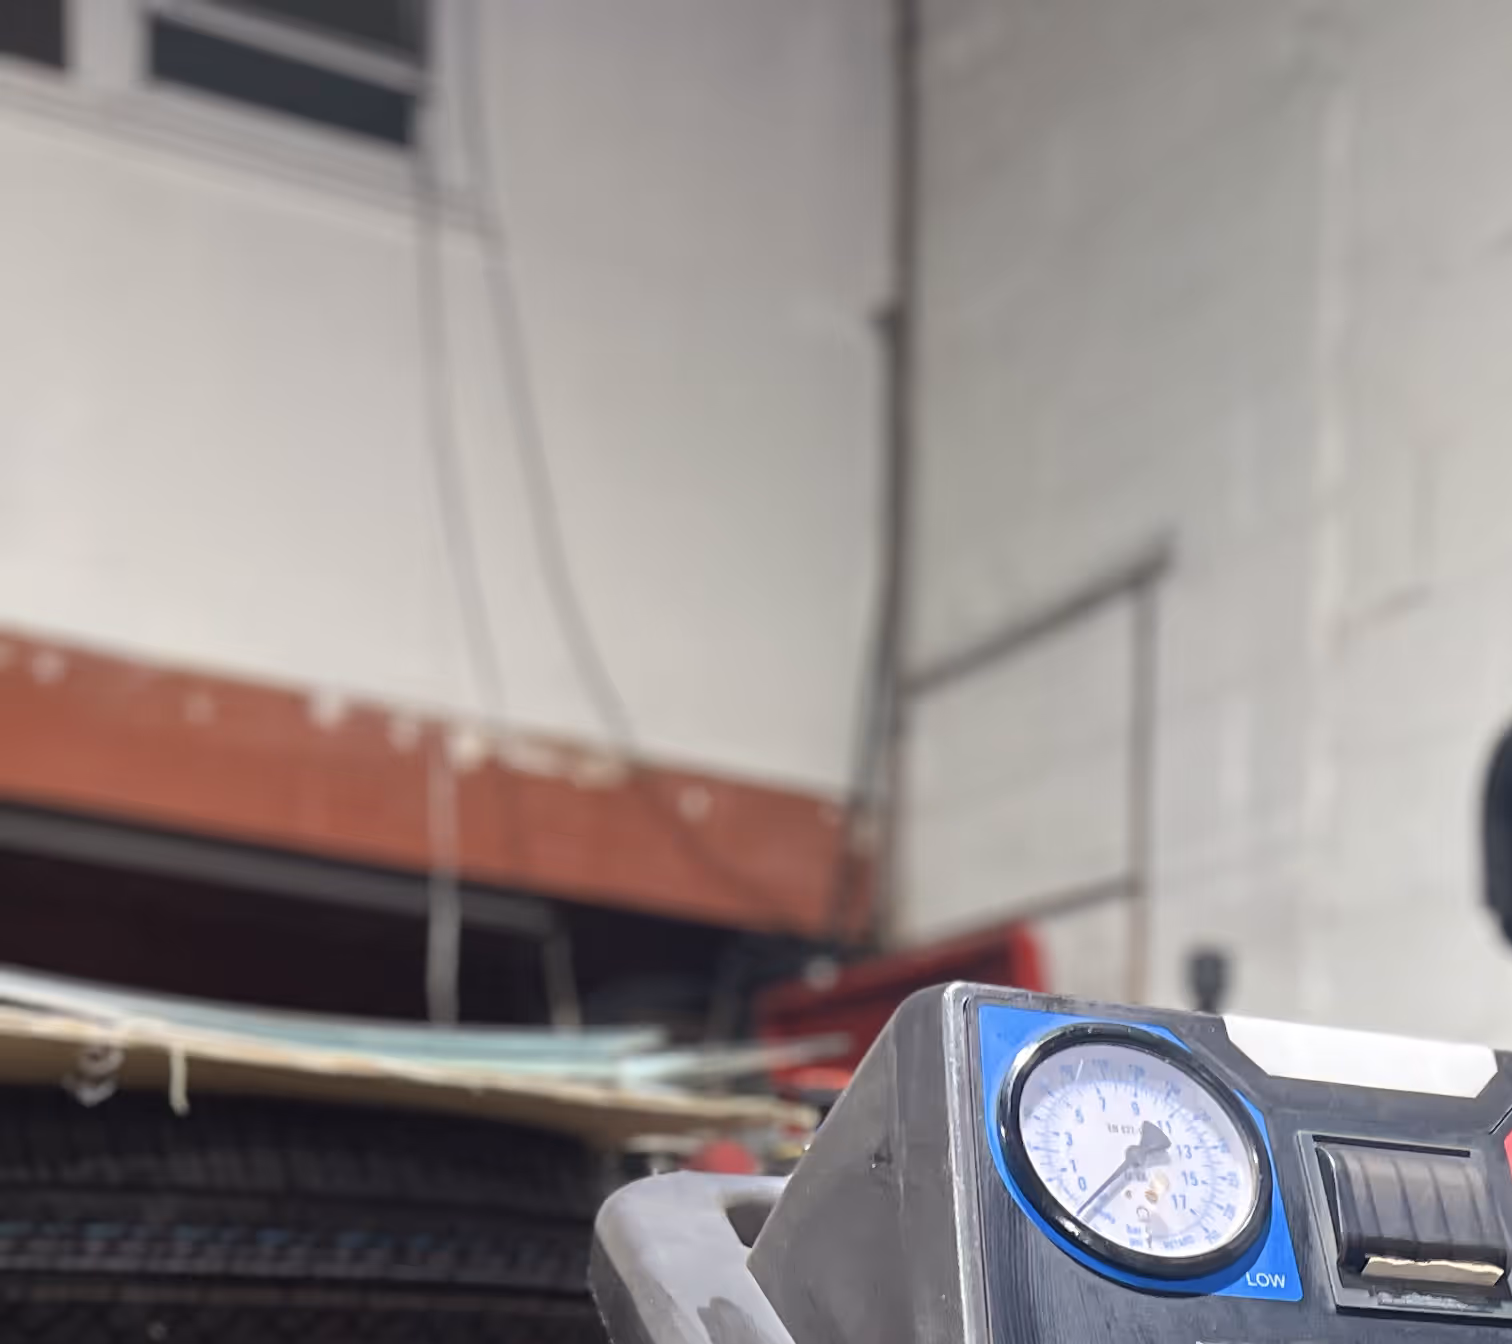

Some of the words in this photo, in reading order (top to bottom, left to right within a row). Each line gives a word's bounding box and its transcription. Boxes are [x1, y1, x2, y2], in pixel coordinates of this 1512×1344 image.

[1177, 1144, 1192, 1159] 13
[1078, 1176, 1087, 1191] 0
[1182, 1171, 1198, 1186] 15
[1171, 1194, 1187, 1210] 17
[1246, 1272, 1286, 1290] LOW
